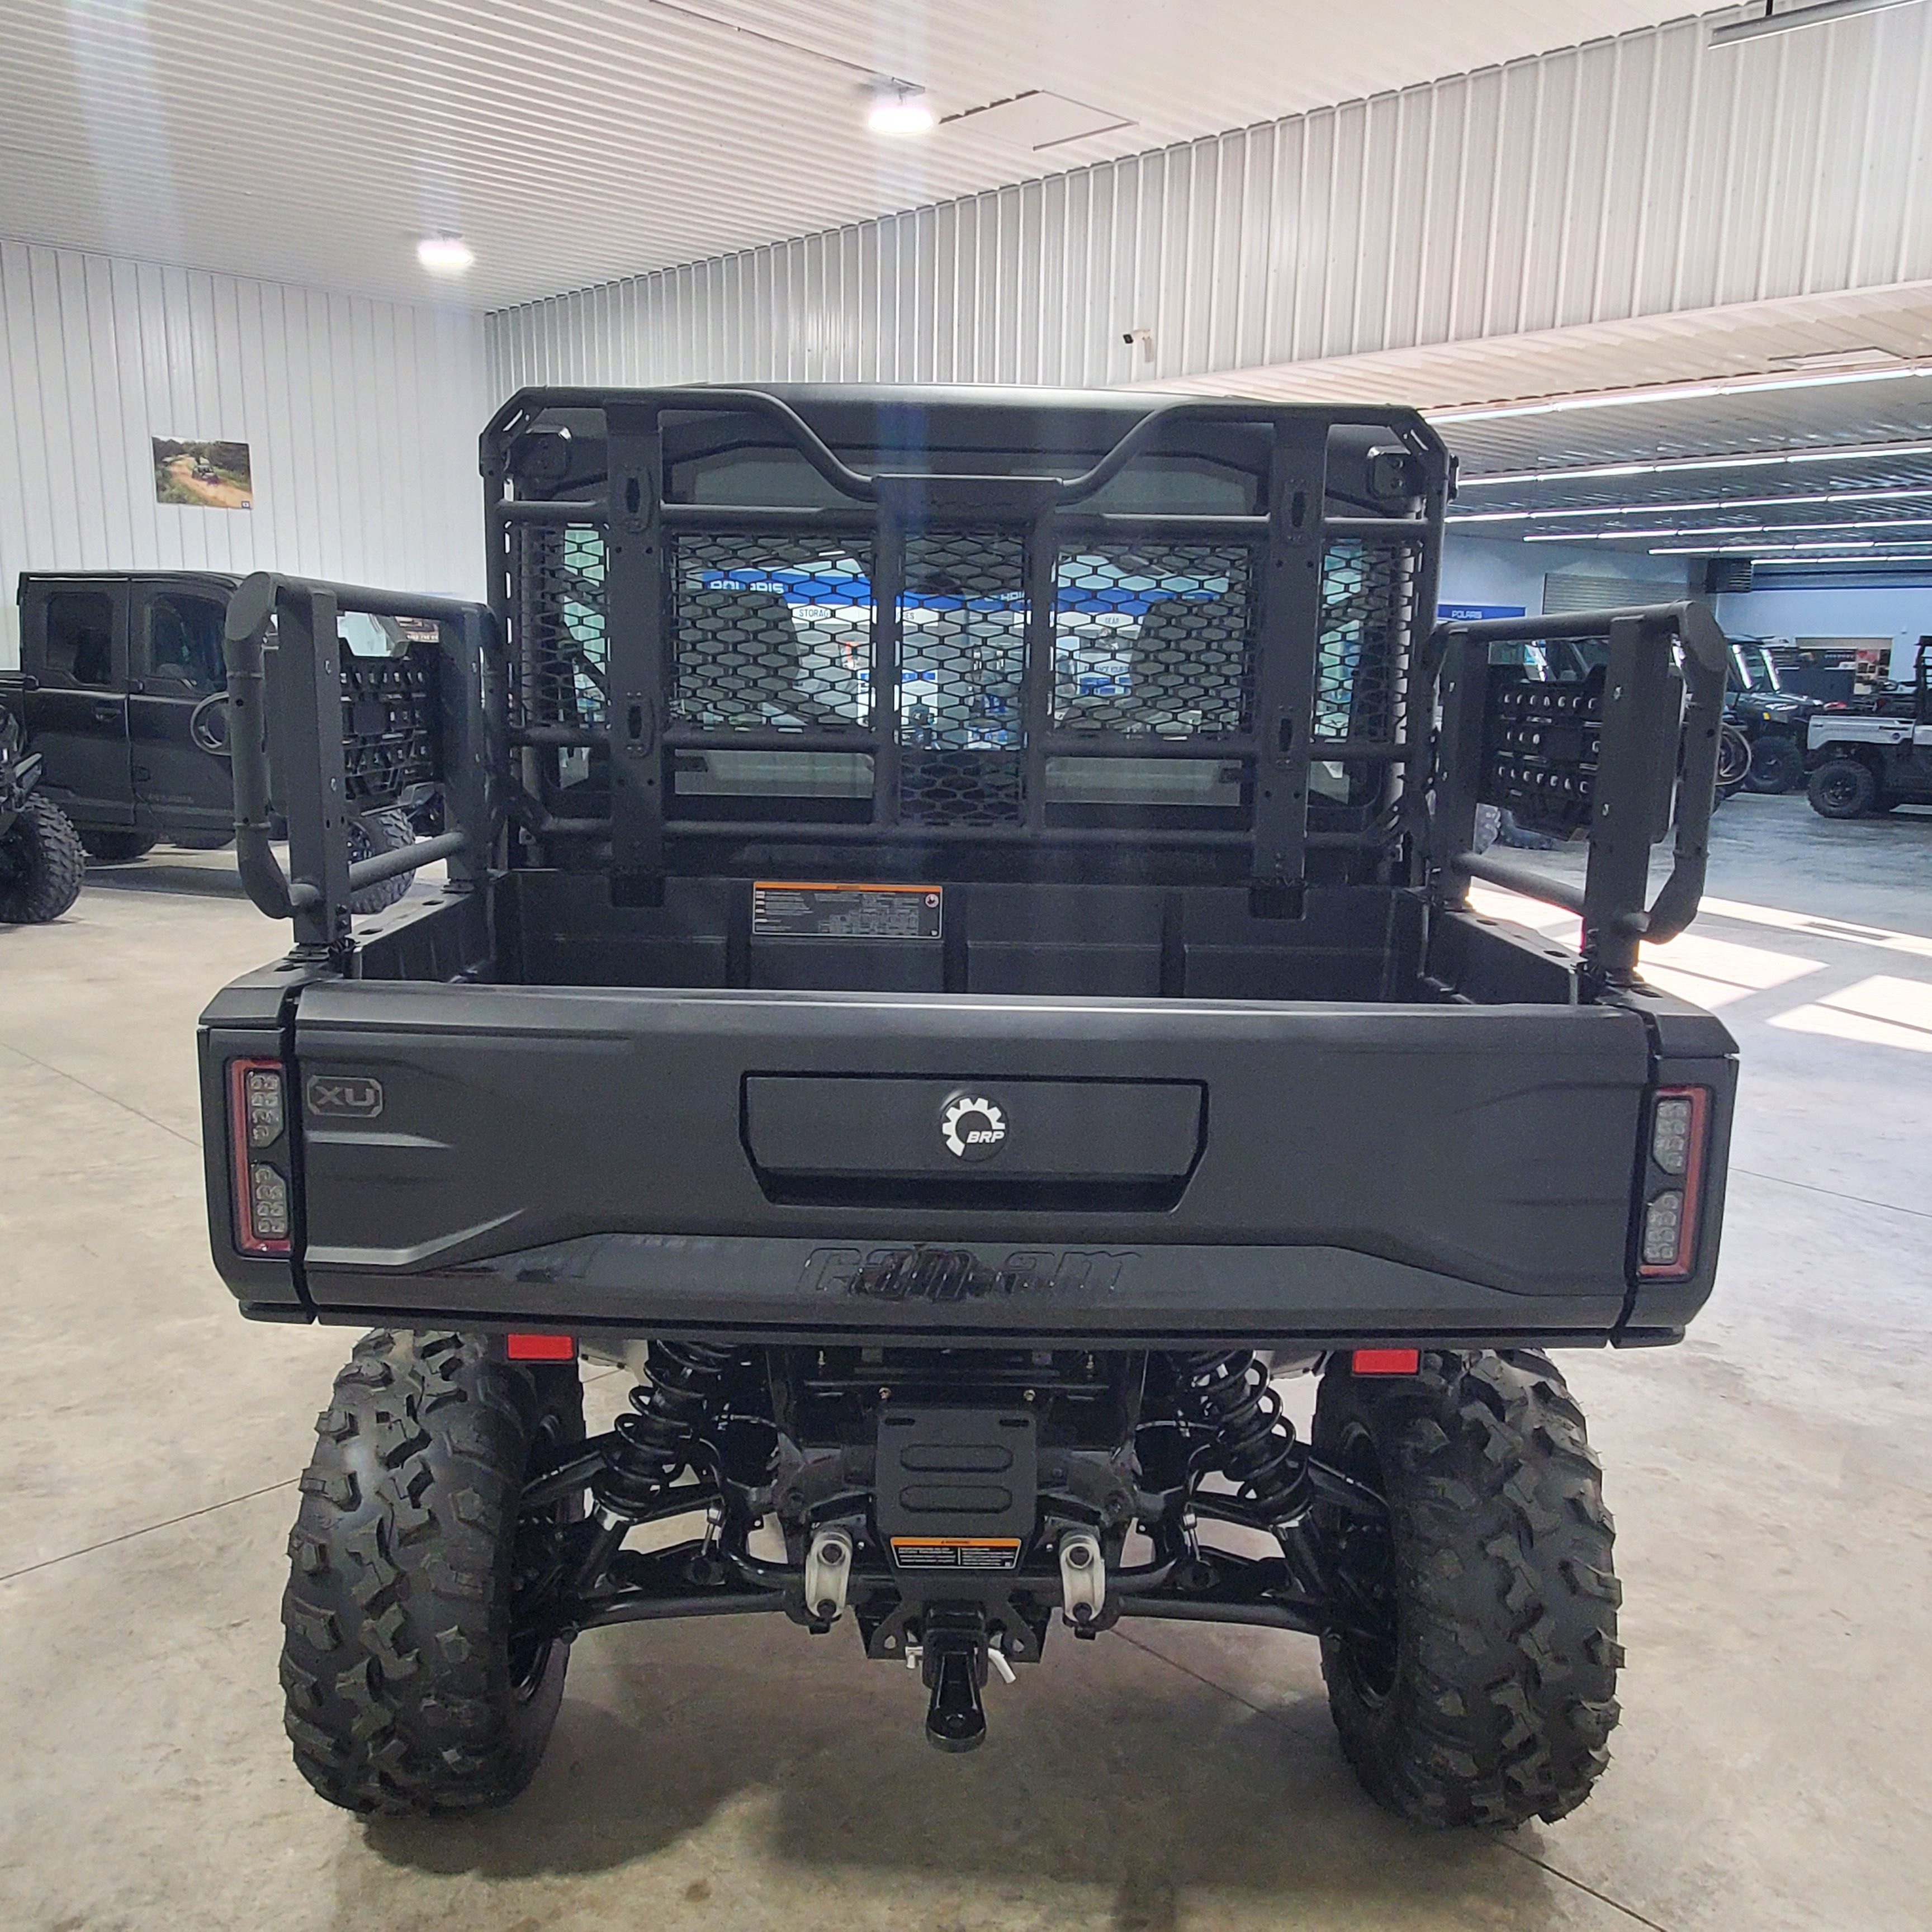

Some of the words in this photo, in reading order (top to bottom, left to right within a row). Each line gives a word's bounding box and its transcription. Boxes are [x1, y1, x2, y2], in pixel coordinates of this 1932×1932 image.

[799, 608, 830, 618] STORAG
[1452, 610, 1482, 619] POLARIS
[315, 1086, 375, 1106] XU
[966, 1131, 1005, 1143] BRP
